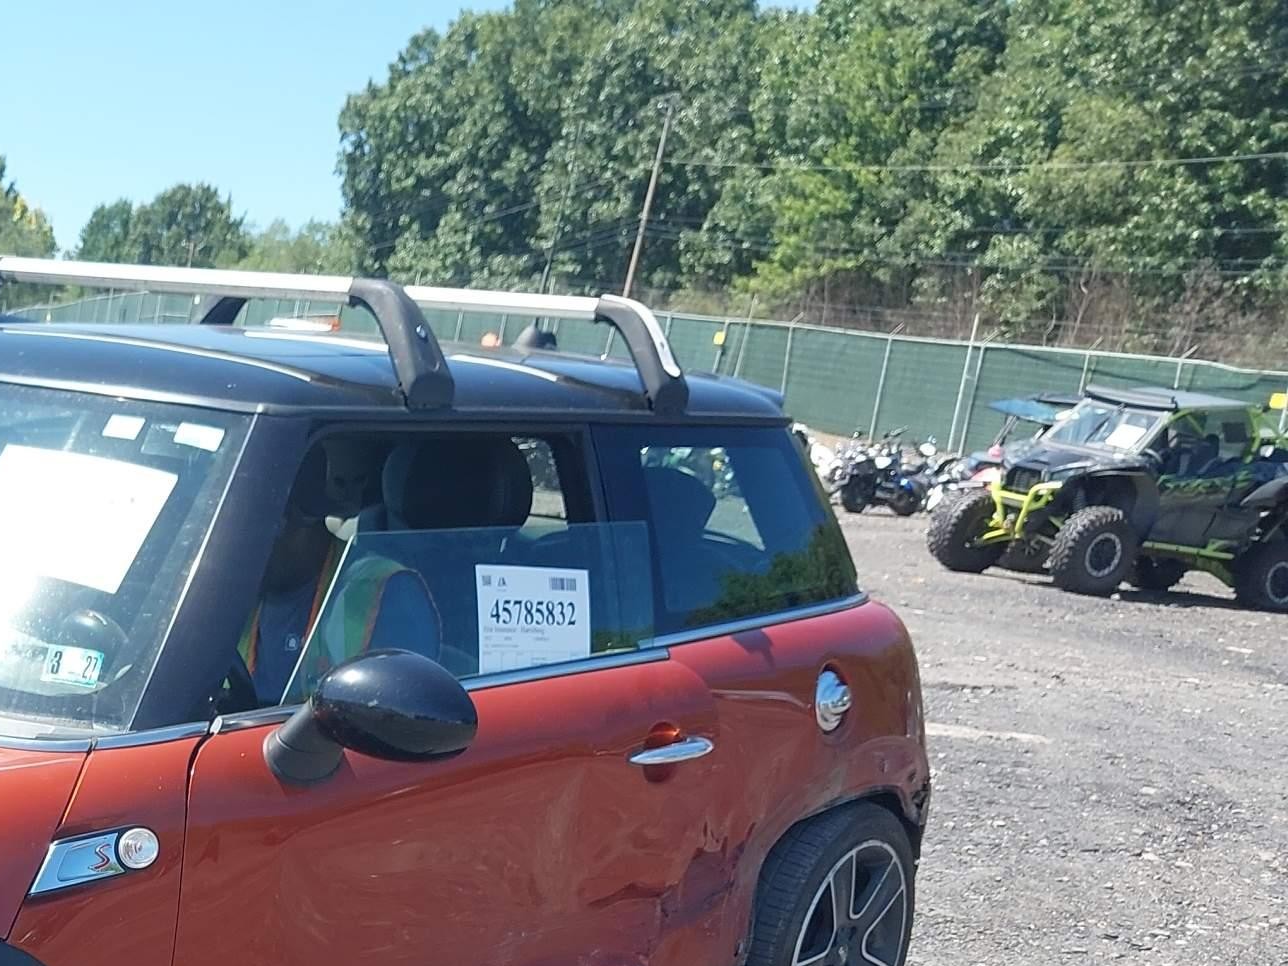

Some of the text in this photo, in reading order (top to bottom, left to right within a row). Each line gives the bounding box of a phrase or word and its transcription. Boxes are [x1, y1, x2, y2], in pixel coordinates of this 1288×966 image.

[490, 599, 576, 626] 45785832
[50, 650, 99, 681] 3 27
